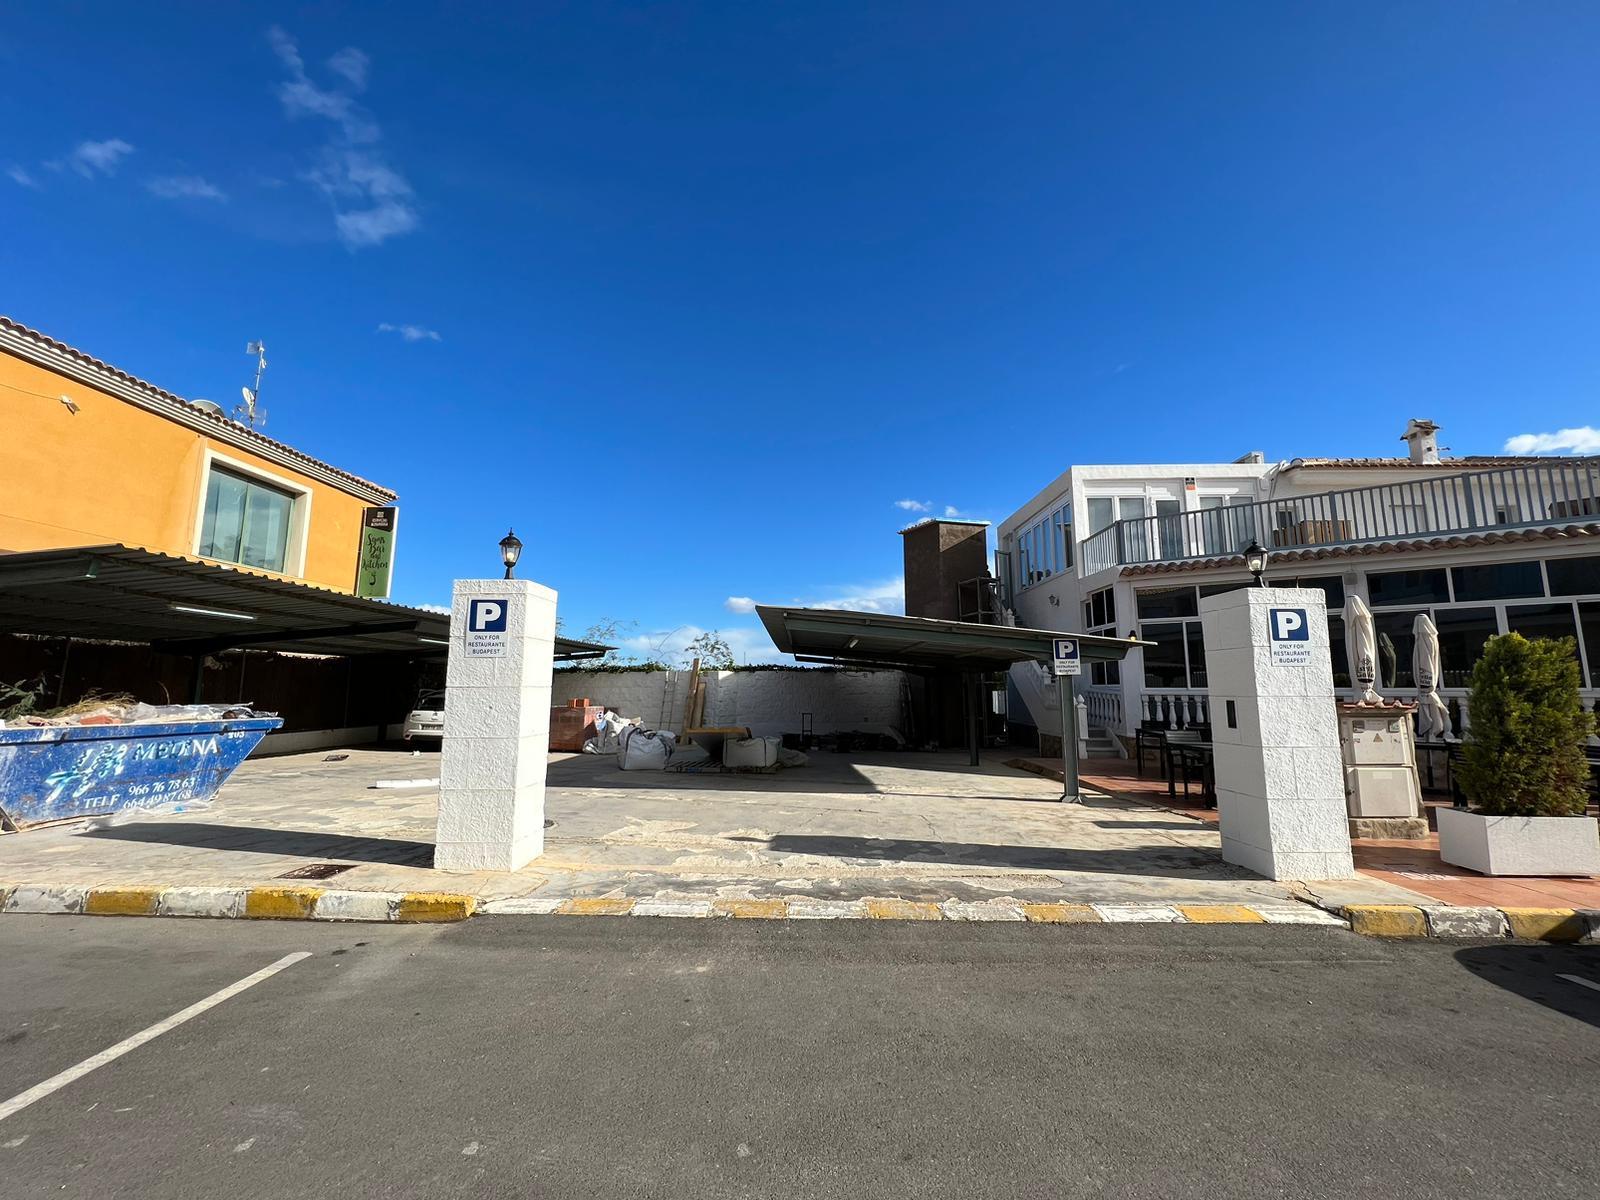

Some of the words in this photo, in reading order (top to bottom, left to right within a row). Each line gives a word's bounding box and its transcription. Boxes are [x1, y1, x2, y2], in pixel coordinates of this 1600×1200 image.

[475, 602, 501, 629] P
[1276, 611, 1301, 639] P
[1058, 641, 1074, 658] P
[134, 736, 218, 761] MEDINA
[128, 784, 150, 796] 966
[152, 781, 165, 793] 76
[182, 777, 196, 788] 63
